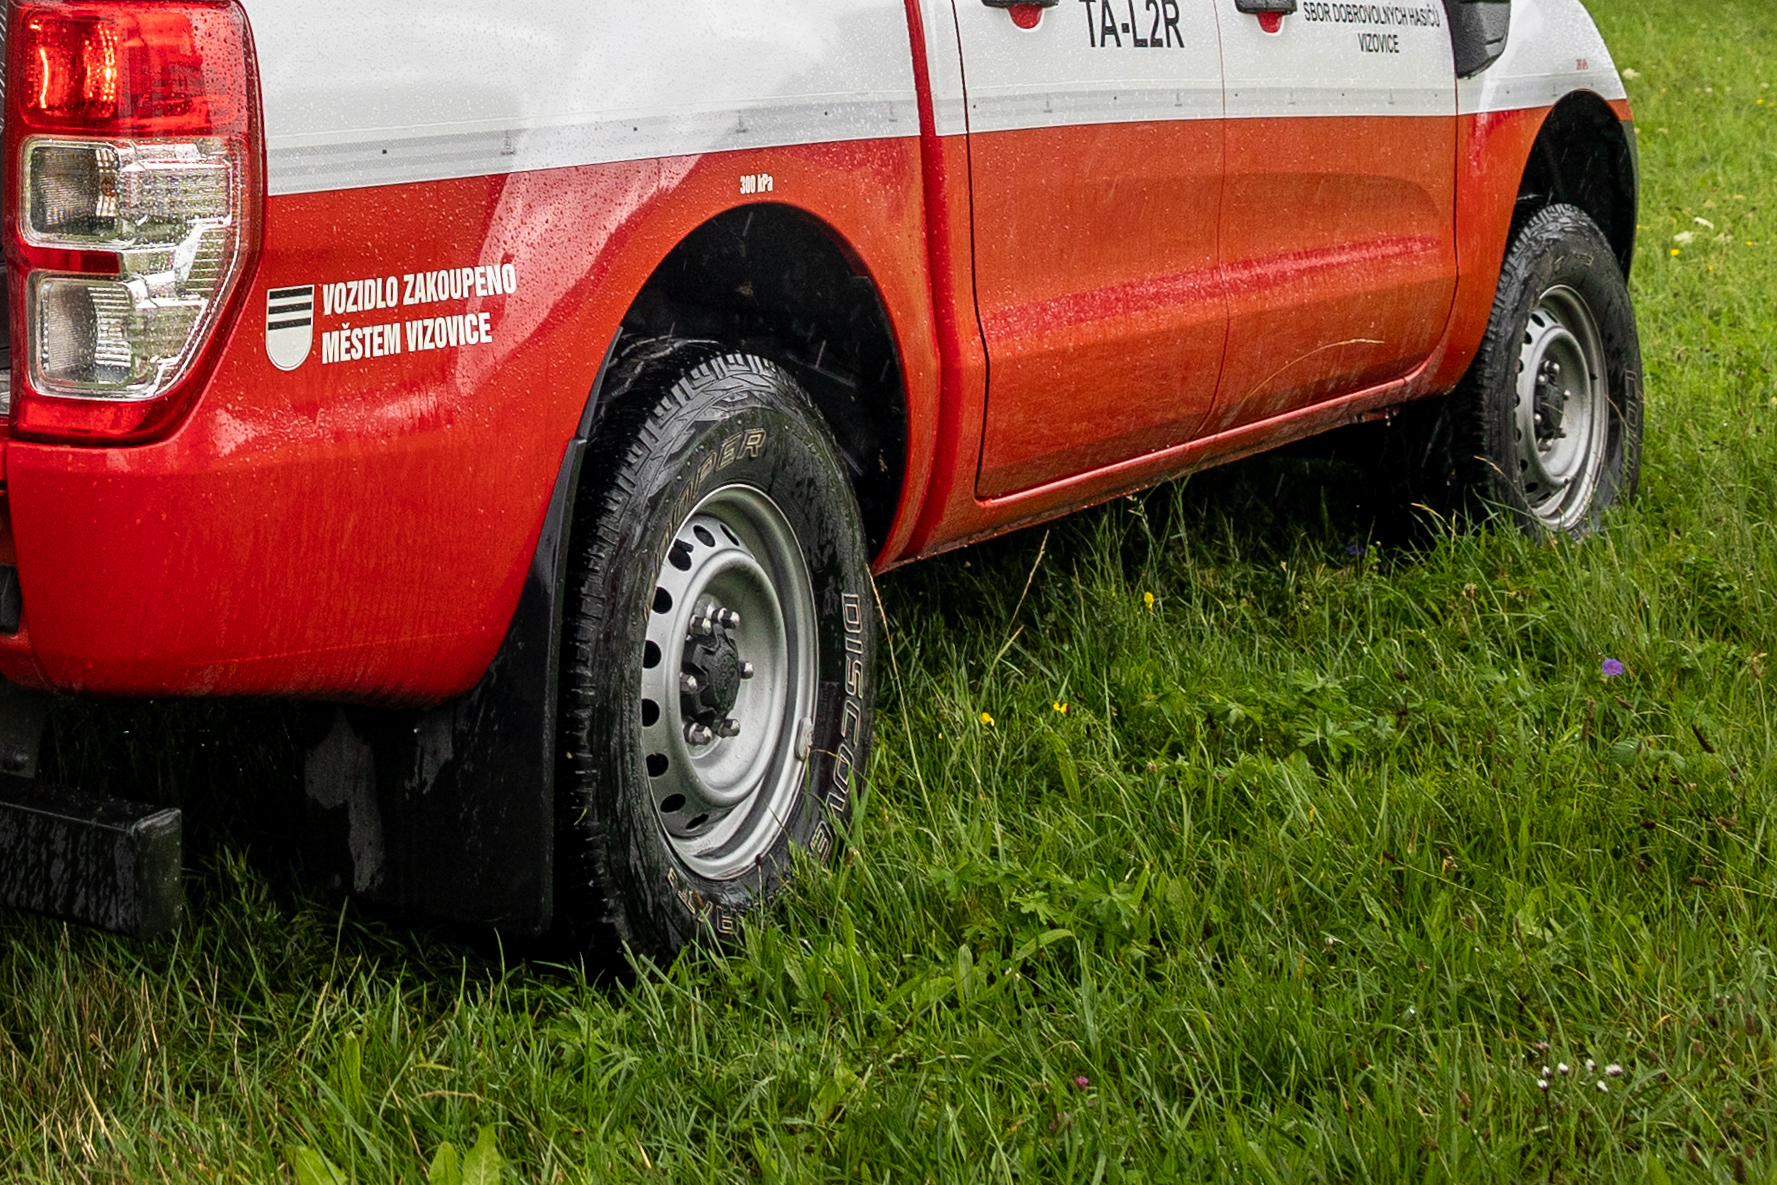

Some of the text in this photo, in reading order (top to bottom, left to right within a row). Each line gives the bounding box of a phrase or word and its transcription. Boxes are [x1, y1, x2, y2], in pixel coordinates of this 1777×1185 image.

[1303, 1, 1332, 22] SBOR
[1332, 2, 1408, 25] DOBROVOLNÝCH
[1357, 33, 1400, 53] VIZOVICE
[739, 173, 774, 195] 300 kPa
[322, 264, 518, 315] VOZIDLO ZAKOUPENO
[322, 311, 493, 364] MĚSTEM VIZOVICE
